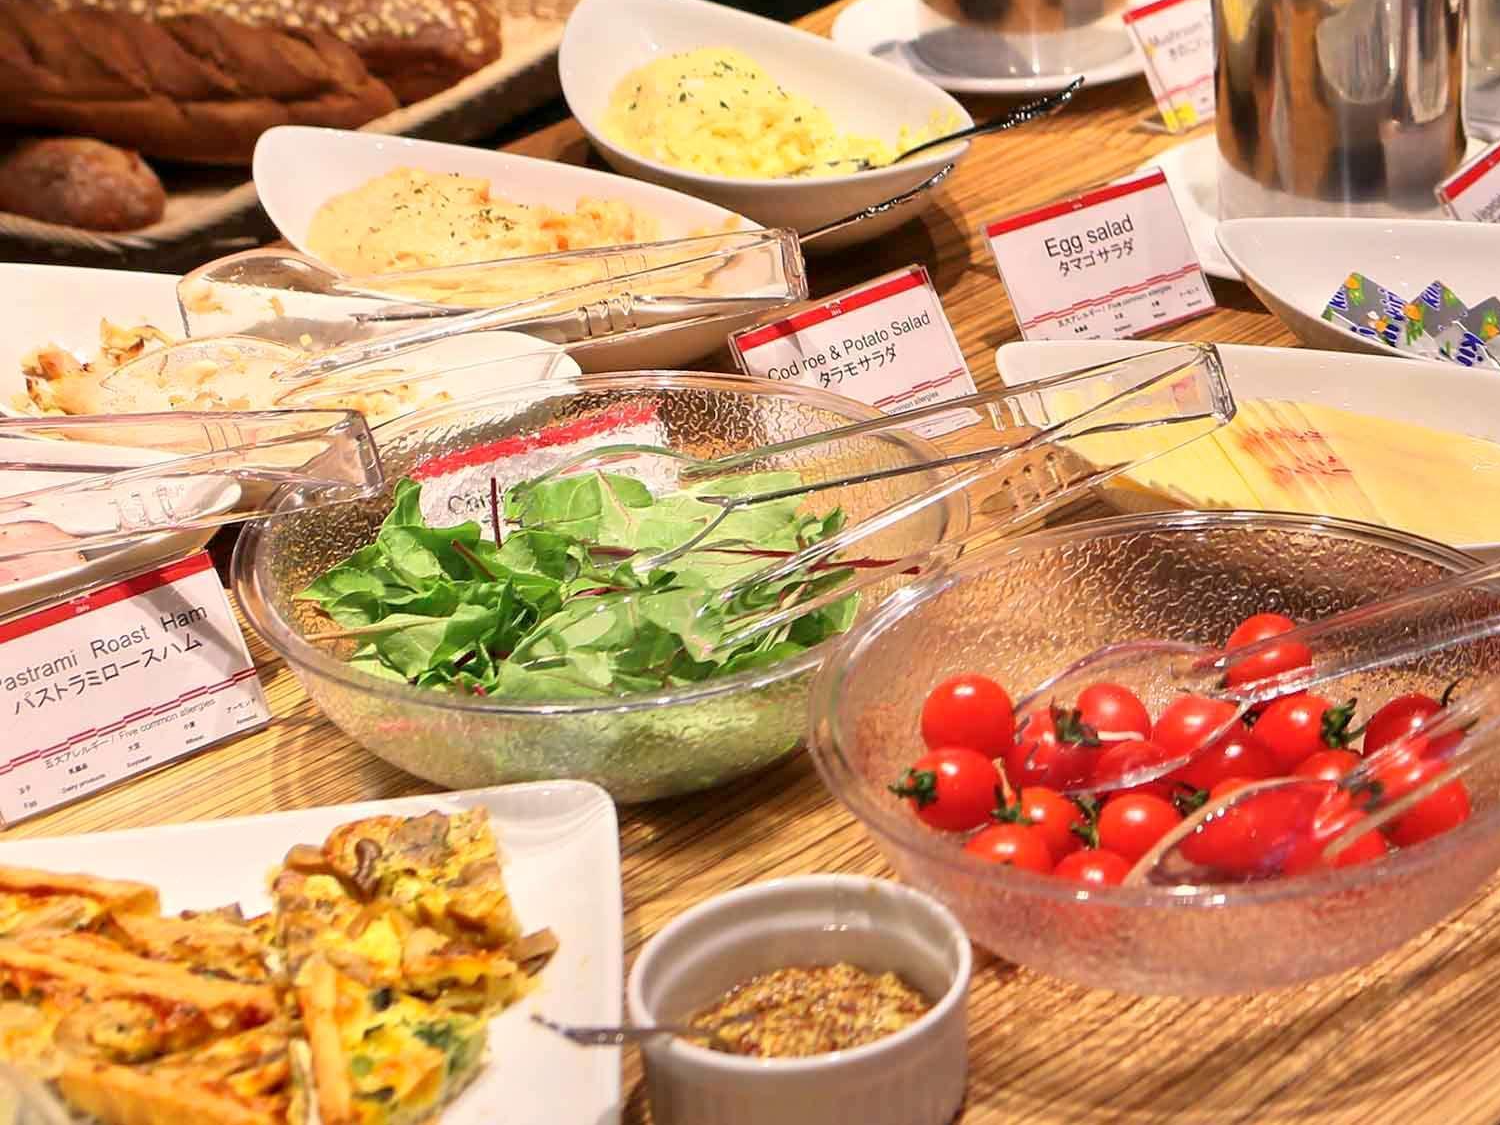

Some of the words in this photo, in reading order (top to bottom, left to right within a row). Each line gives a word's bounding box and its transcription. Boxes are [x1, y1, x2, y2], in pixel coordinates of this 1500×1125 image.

[1044, 234, 1084, 258] Egg
[1087, 213, 1135, 245] salad
[1058, 238, 1135, 277] タマゴサラダ
[768, 360, 799, 380] Cod
[802, 354, 826, 371] roe
[829, 345, 842, 361] &
[843, 329, 889, 356] Potato
[890, 310, 931, 337] Salad
[819, 343, 898, 389] タラモサラダ
[0, 649, 79, 692] astrami
[90, 624, 151, 659] Roast
[160, 605, 208, 633] Ham
[14, 633, 203, 716] パストラミロースハム
[118, 727, 138, 742] Five
[140, 713, 178, 733] common
[179, 698, 217, 719] allergies
